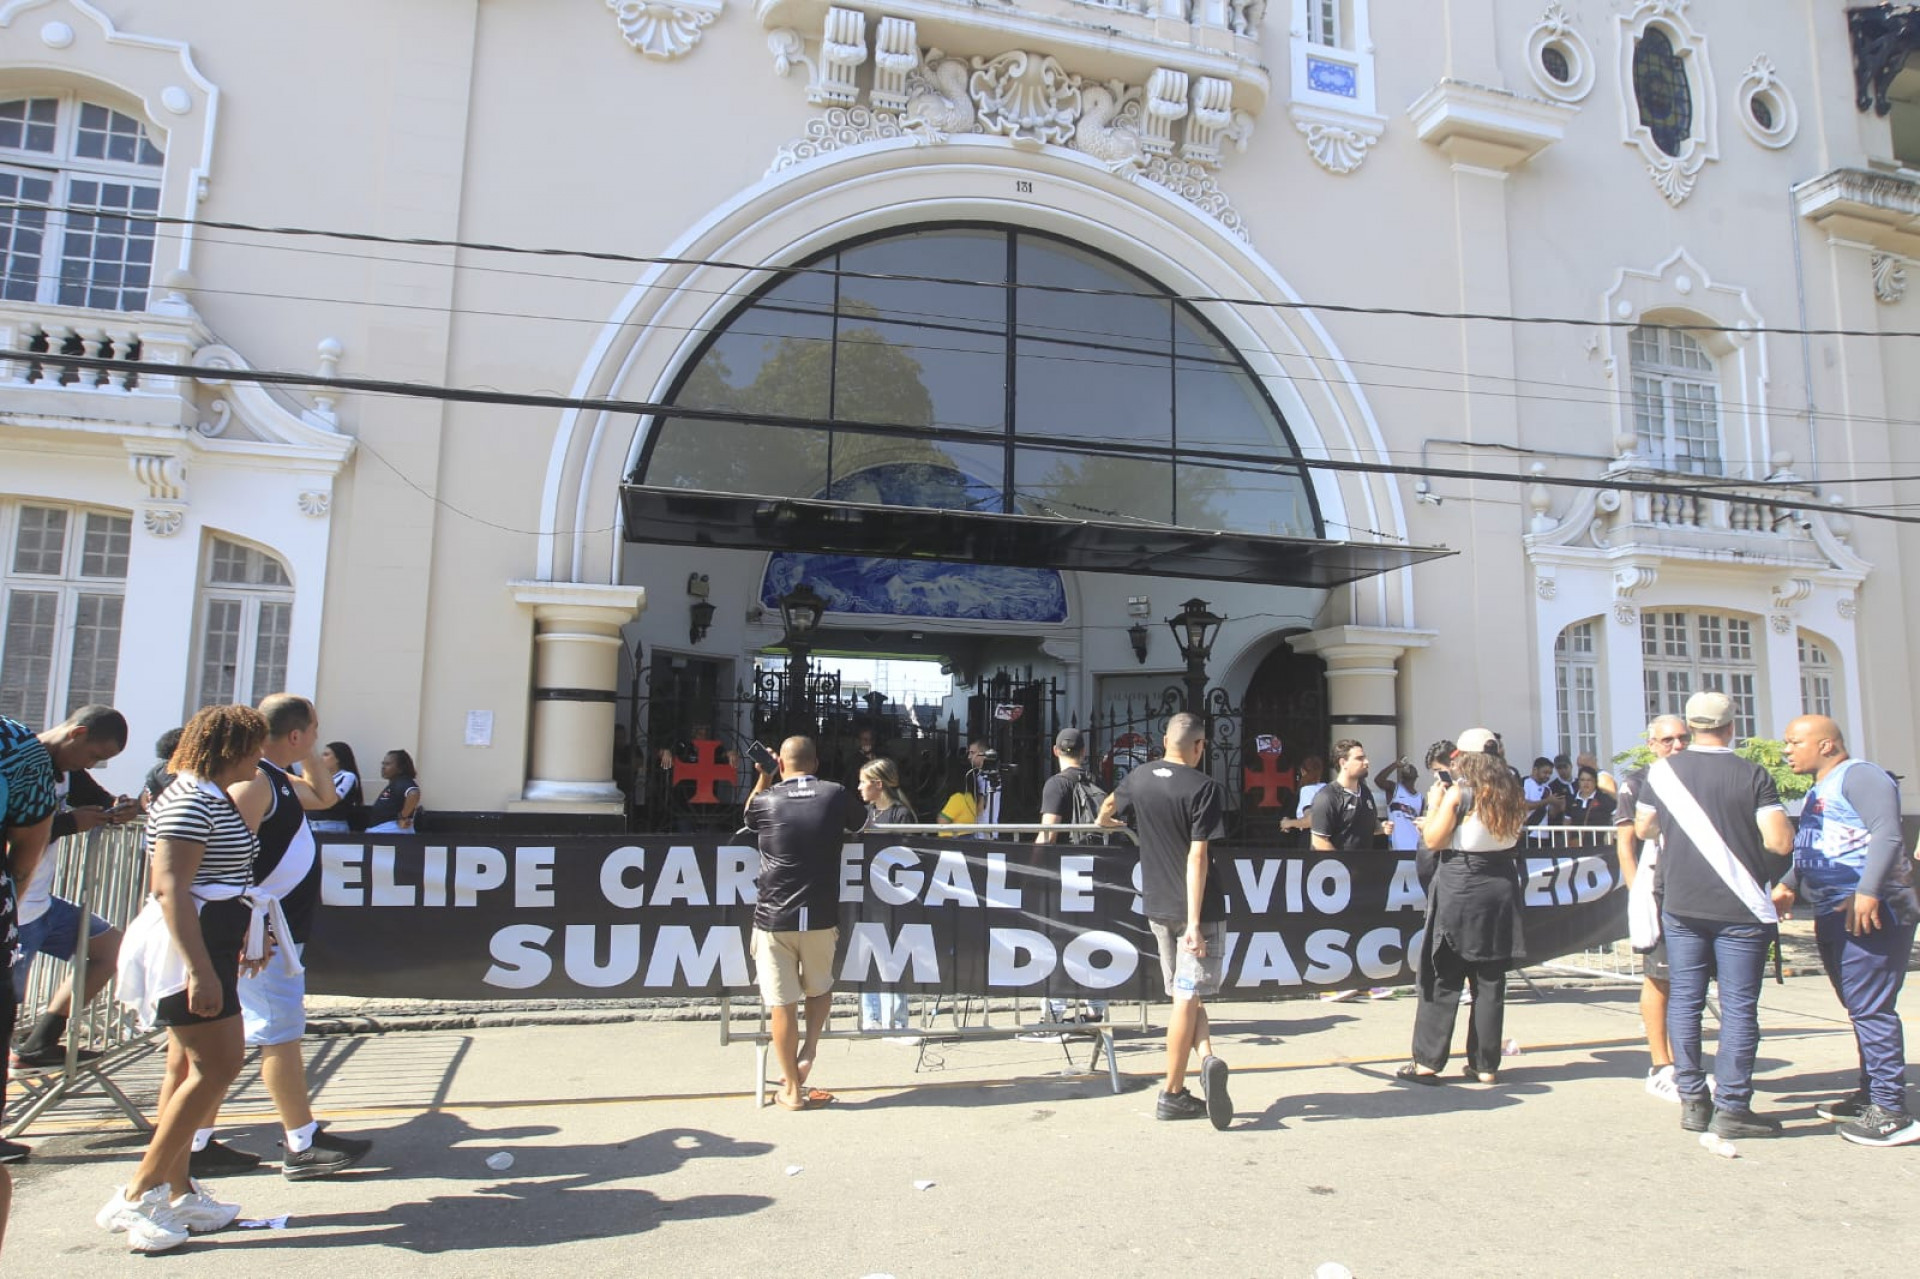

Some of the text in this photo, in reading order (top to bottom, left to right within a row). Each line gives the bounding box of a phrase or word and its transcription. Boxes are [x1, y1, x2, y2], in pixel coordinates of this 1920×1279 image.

[321, 844, 555, 907] ELIPE
[600, 842, 1021, 909] CAREGAL
[1060, 854, 1093, 912] E
[1385, 855, 1626, 912] AEID
[482, 923, 940, 989] SUMM
[988, 928, 1139, 989] DO
